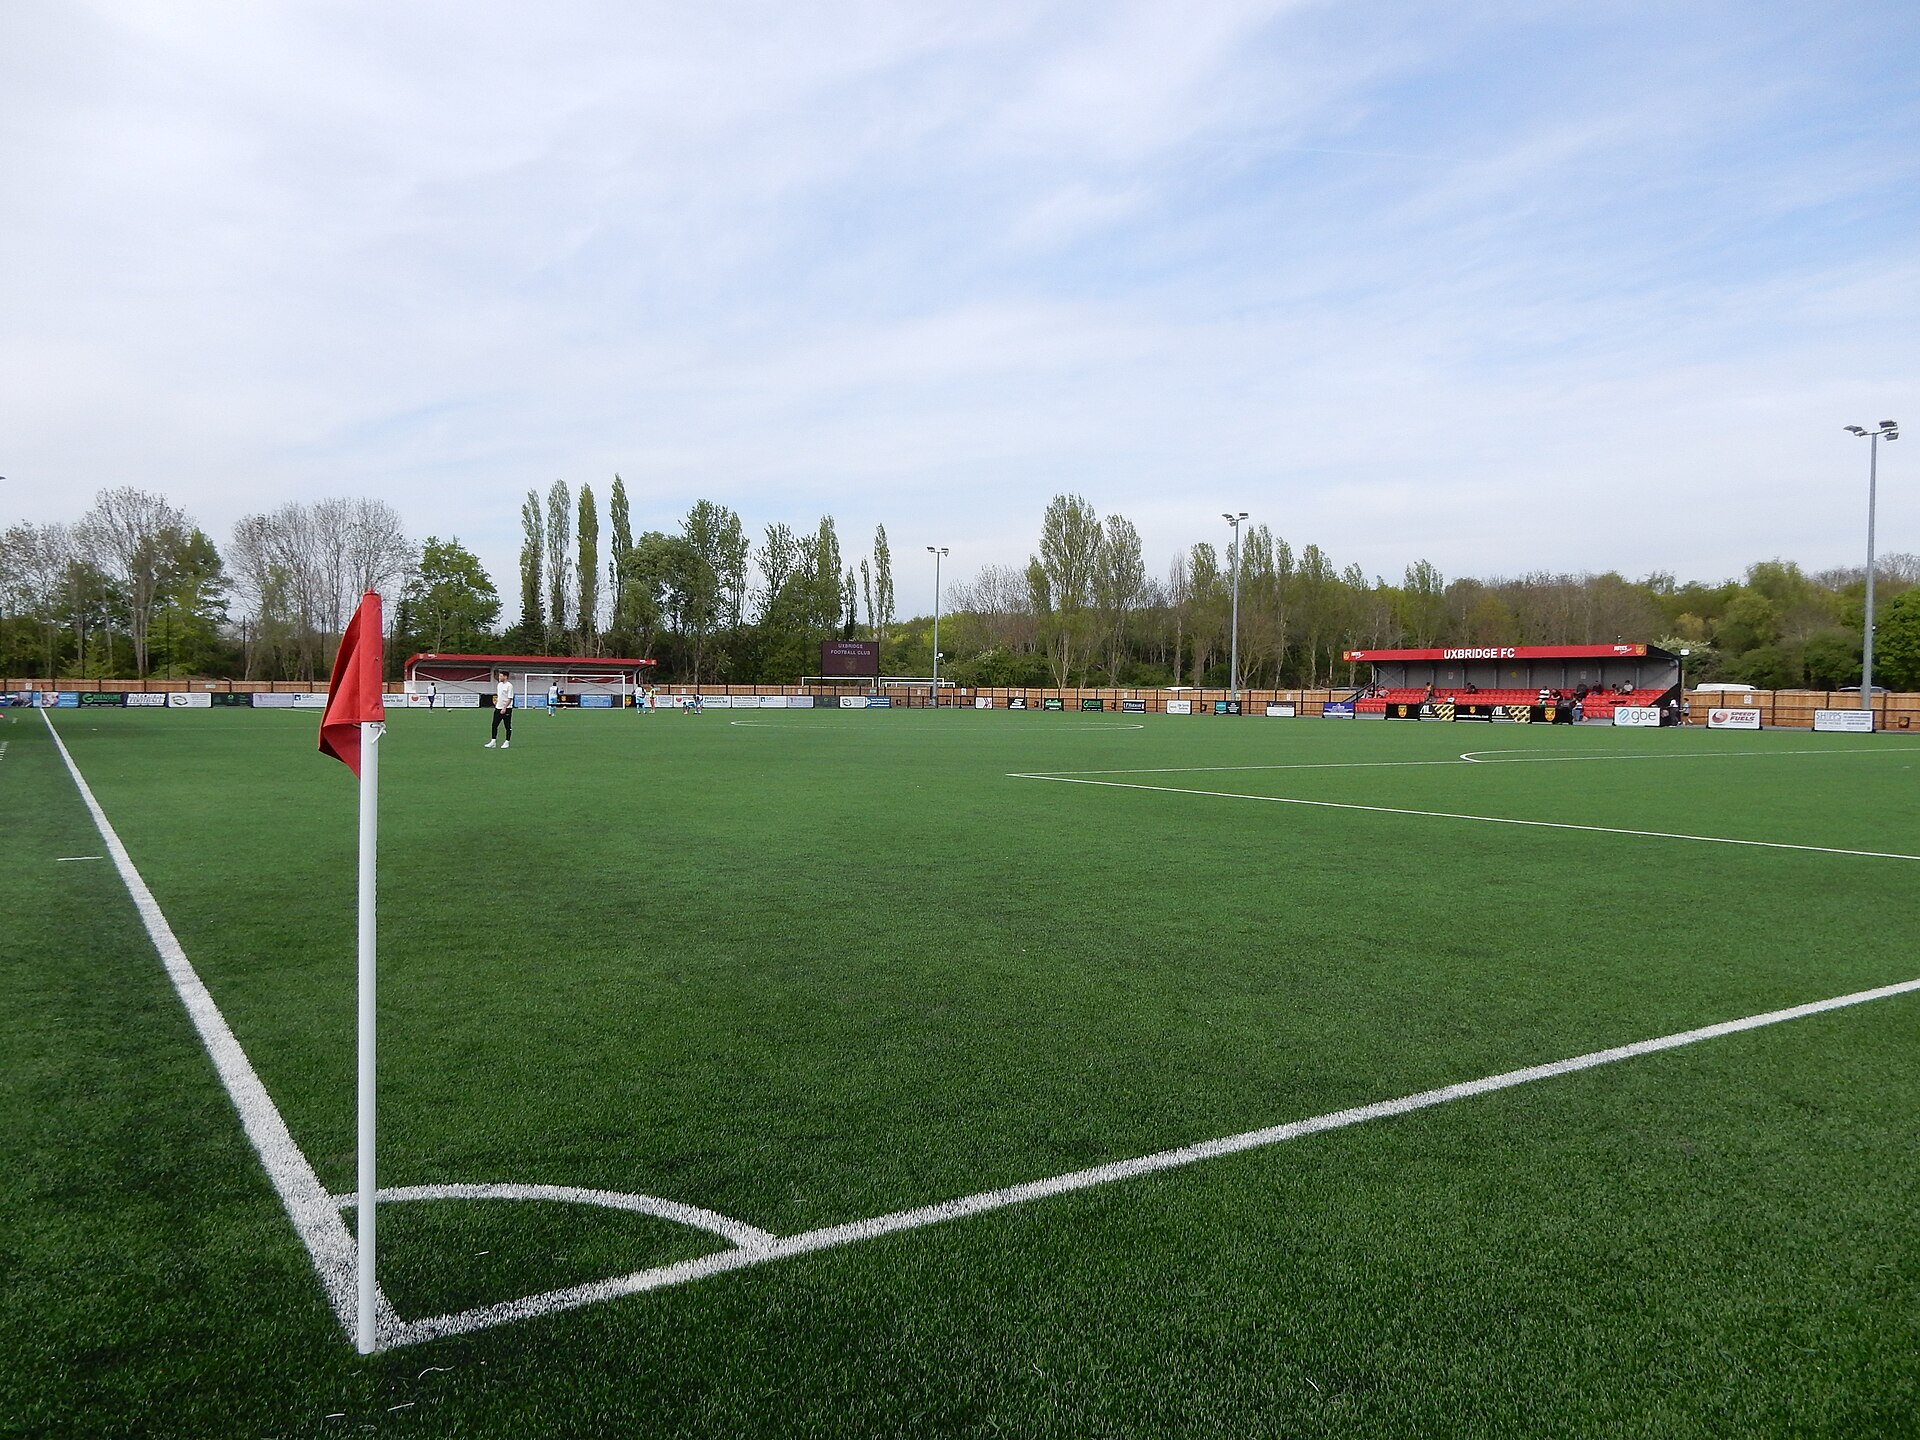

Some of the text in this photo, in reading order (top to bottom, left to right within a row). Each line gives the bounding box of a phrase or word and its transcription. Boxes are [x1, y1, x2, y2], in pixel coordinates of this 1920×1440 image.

[1444, 648, 1515, 659] UXBRIDGE FC
[1631, 709, 1657, 724] gbe
[1816, 711, 1842, 720] SHIPPS
